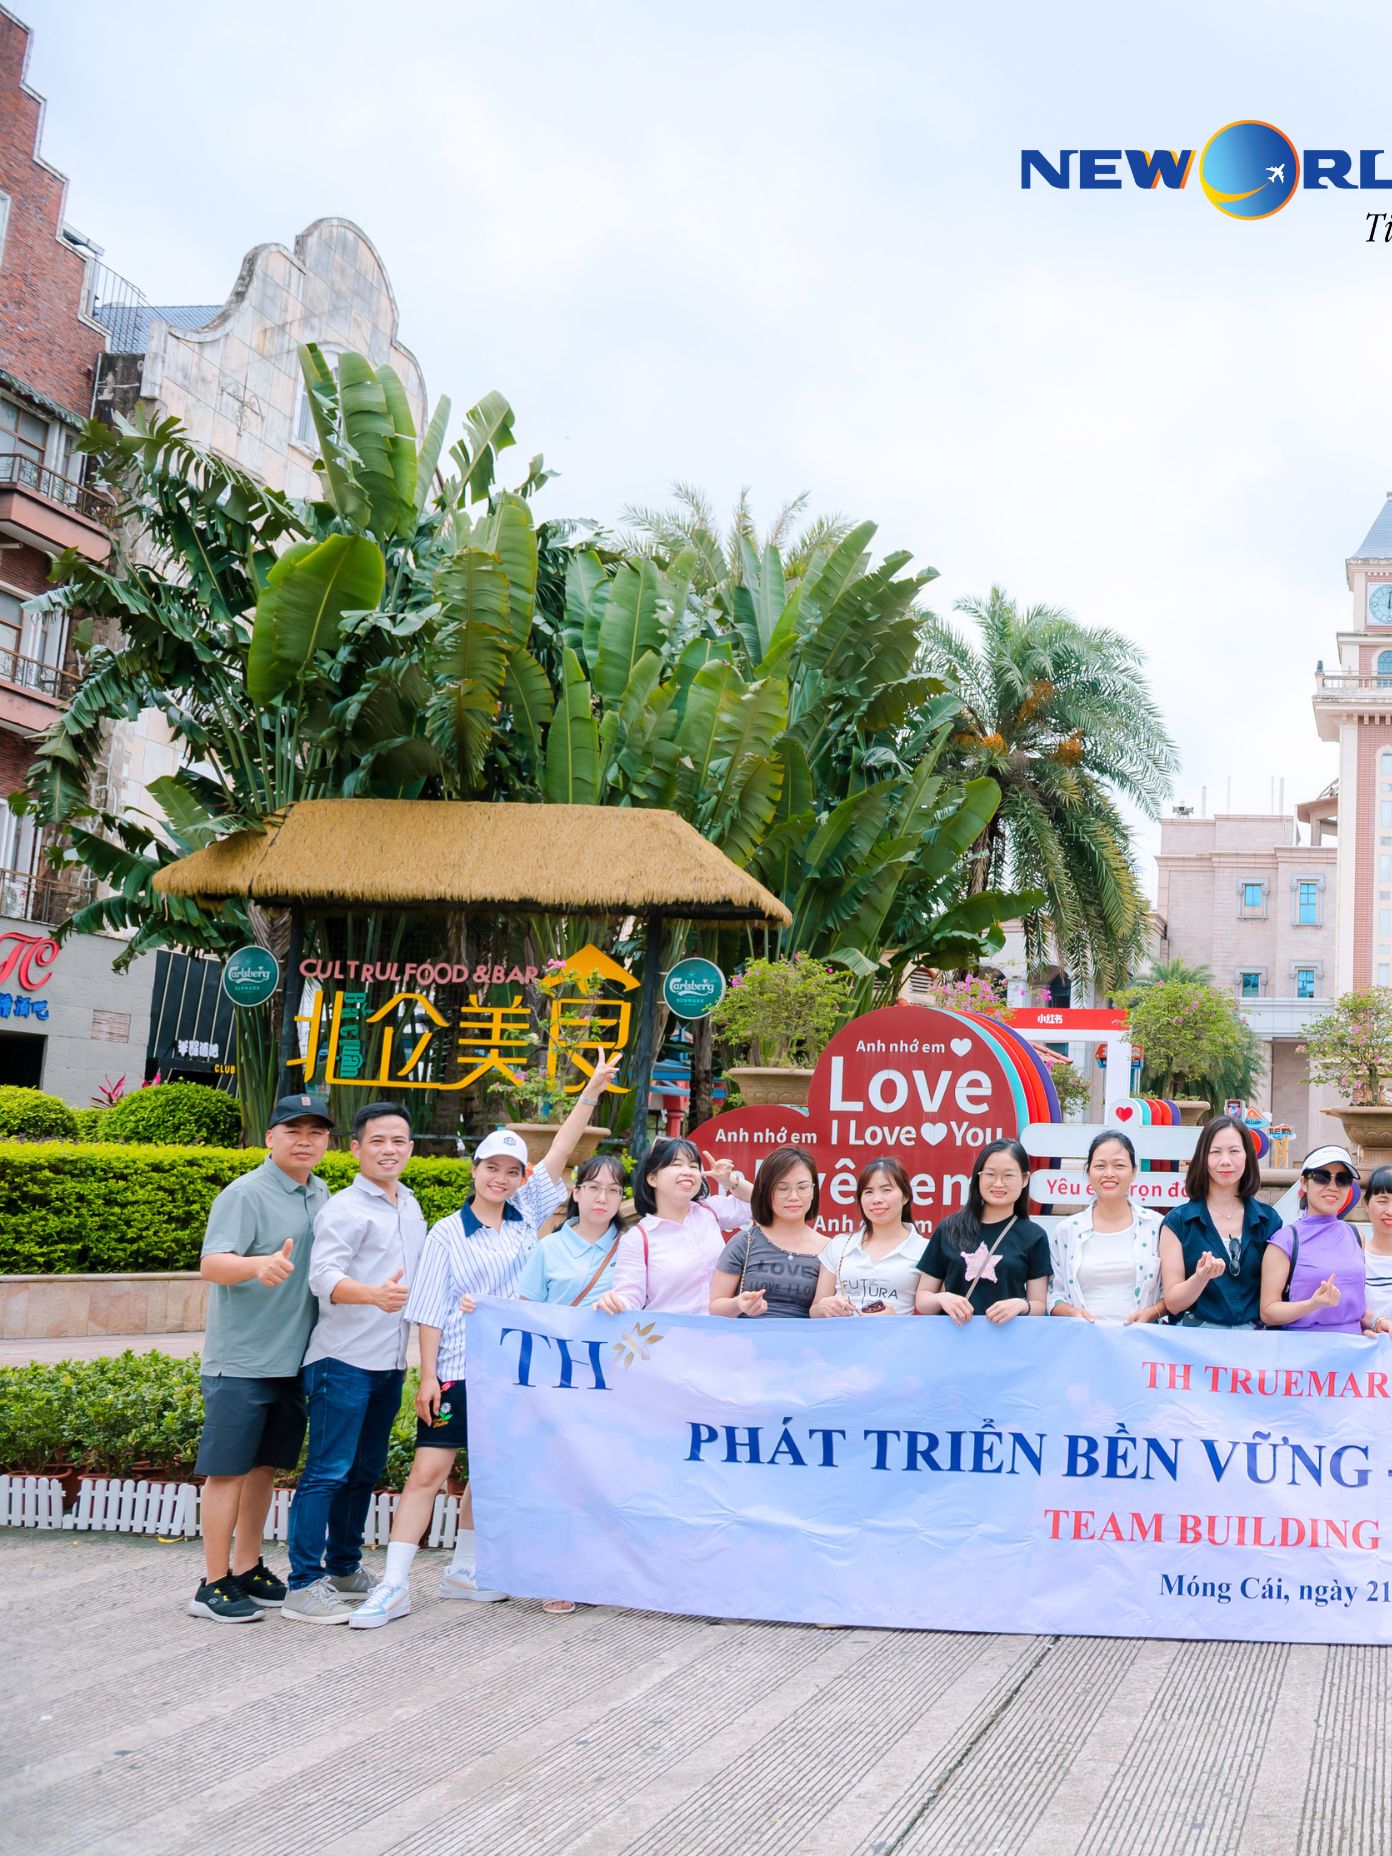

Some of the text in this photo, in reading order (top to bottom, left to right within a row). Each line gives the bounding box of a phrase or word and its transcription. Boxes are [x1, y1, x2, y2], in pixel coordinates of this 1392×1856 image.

[228, 966, 270, 984] Carlsberg
[670, 977, 715, 996] Carlsberg
[1037, 1014, 1063, 1024] 小红书
[856, 1039, 945, 1054] Anh nhớ em
[214, 1063, 236, 1074] CLUB
[829, 1055, 993, 1114] Love
[716, 1126, 817, 1144] Anh nhớ em
[831, 1119, 1002, 1147] I Love You
[1047, 1178, 1080, 1196] Yêu
[1130, 1183, 1162, 1201] rọn
[814, 1214, 854, 1233] Anh
[758, 1259, 812, 1277] LOVE
[499, 1327, 613, 1391] TH
[1142, 1361, 1192, 1391] TH
[683, 1416, 846, 1468] PHÁT
[864, 1417, 1047, 1477] TRIỂN
[1062, 1422, 1183, 1481] BỀN
[1200, 1431, 1372, 1488] VỮNG
[1043, 1509, 1165, 1543] TEAM
[1176, 1513, 1381, 1551] BUILDING
[1158, 1573, 1232, 1605] Móng
[1239, 1575, 1291, 1605] Cái,
[1299, 1580, 1358, 1608] ngày
